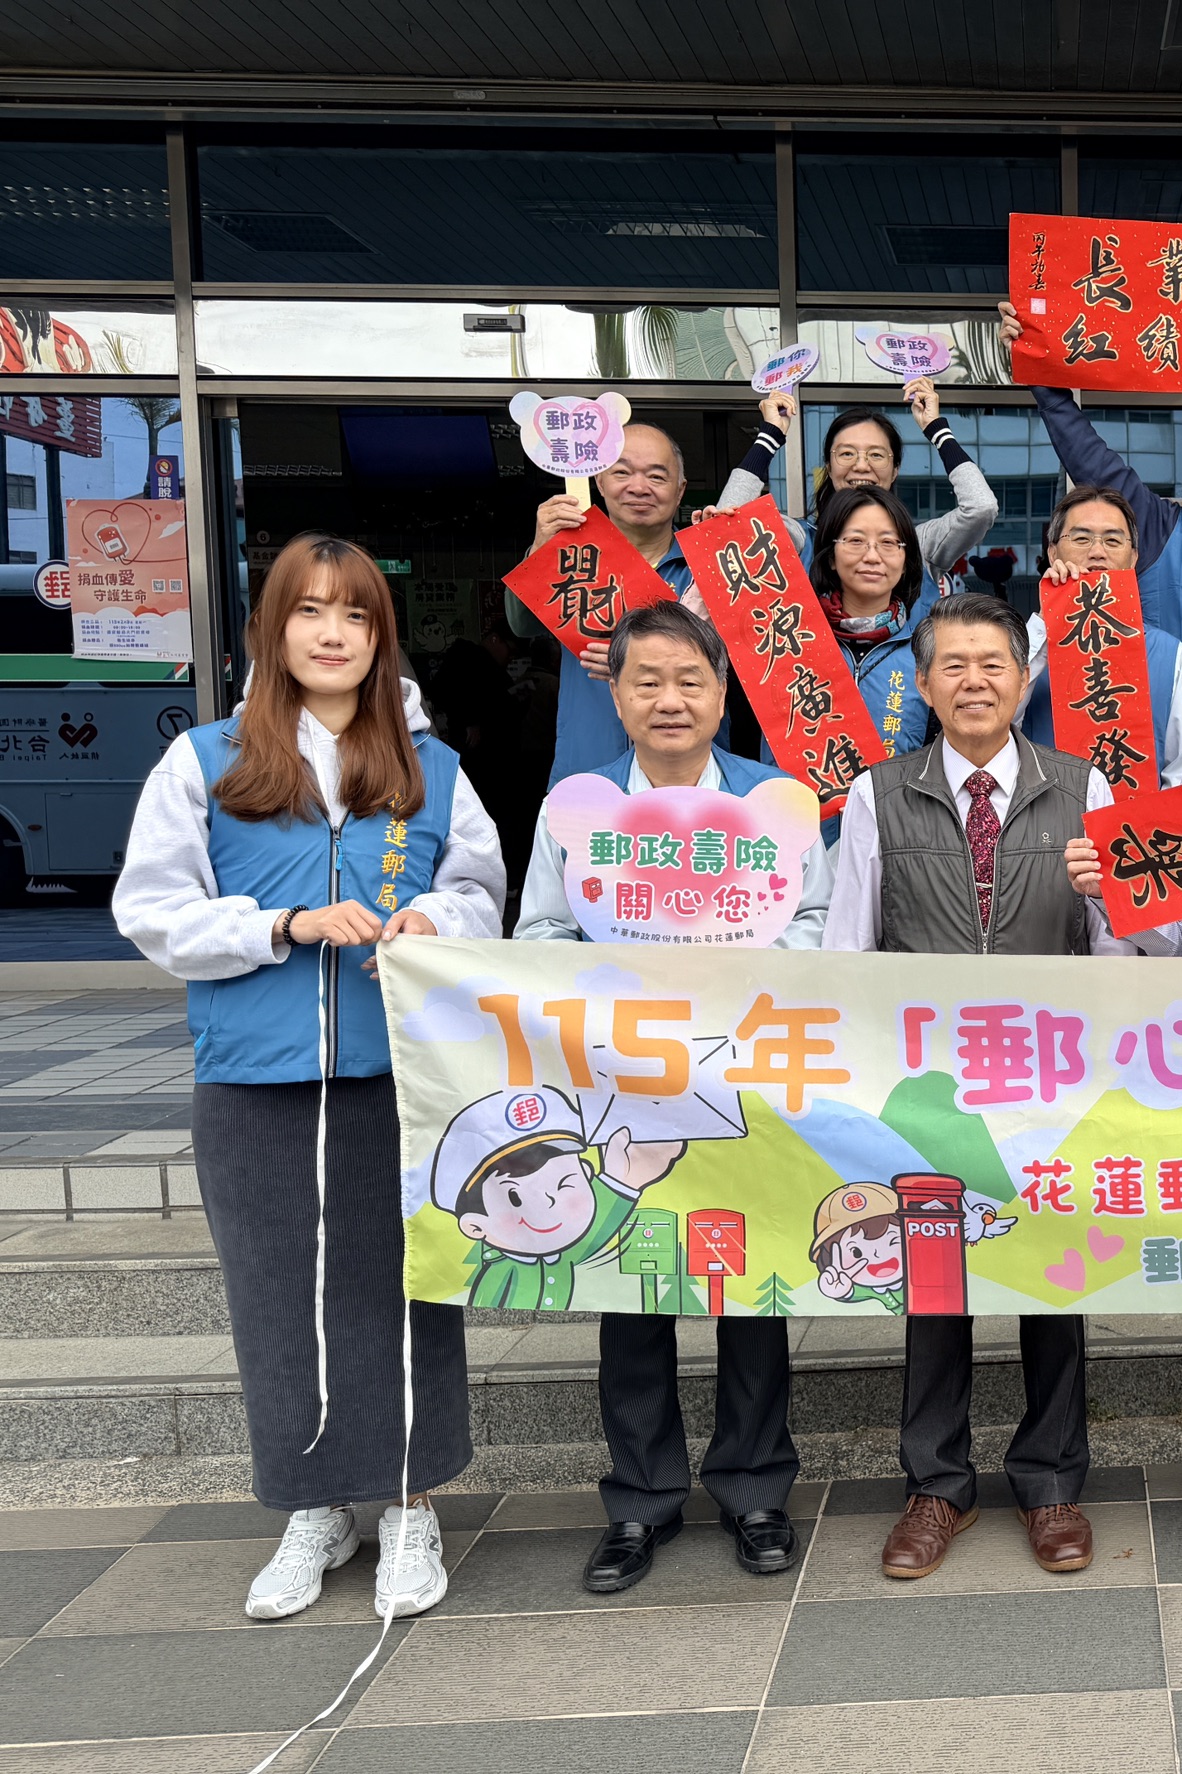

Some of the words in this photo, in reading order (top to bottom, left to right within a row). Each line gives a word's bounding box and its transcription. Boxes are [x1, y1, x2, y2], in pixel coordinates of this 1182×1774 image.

[886, 337, 928, 351] 郵政
[766, 348, 806, 372] 郵你
[891, 352, 932, 367] 壽險
[764, 362, 803, 386] 郵我
[545, 410, 598, 431] 郵政
[550, 438, 599, 464] 壽險
[157, 476, 173, 500] 請脫
[77, 569, 135, 586] 捐血傳愛
[94, 589, 147, 604] 守護生命
[715, 517, 871, 804] 財源廣進
[1058, 573, 1150, 798] 恭喜發
[588, 829, 779, 874] 郵政壽險
[615, 882, 751, 923] 關心您
[609, 925, 755, 944] 中華郵政股份有限公司花蓮郵局
[477, 993, 851, 1112] 115年
[908, 1221, 959, 1237] POST
